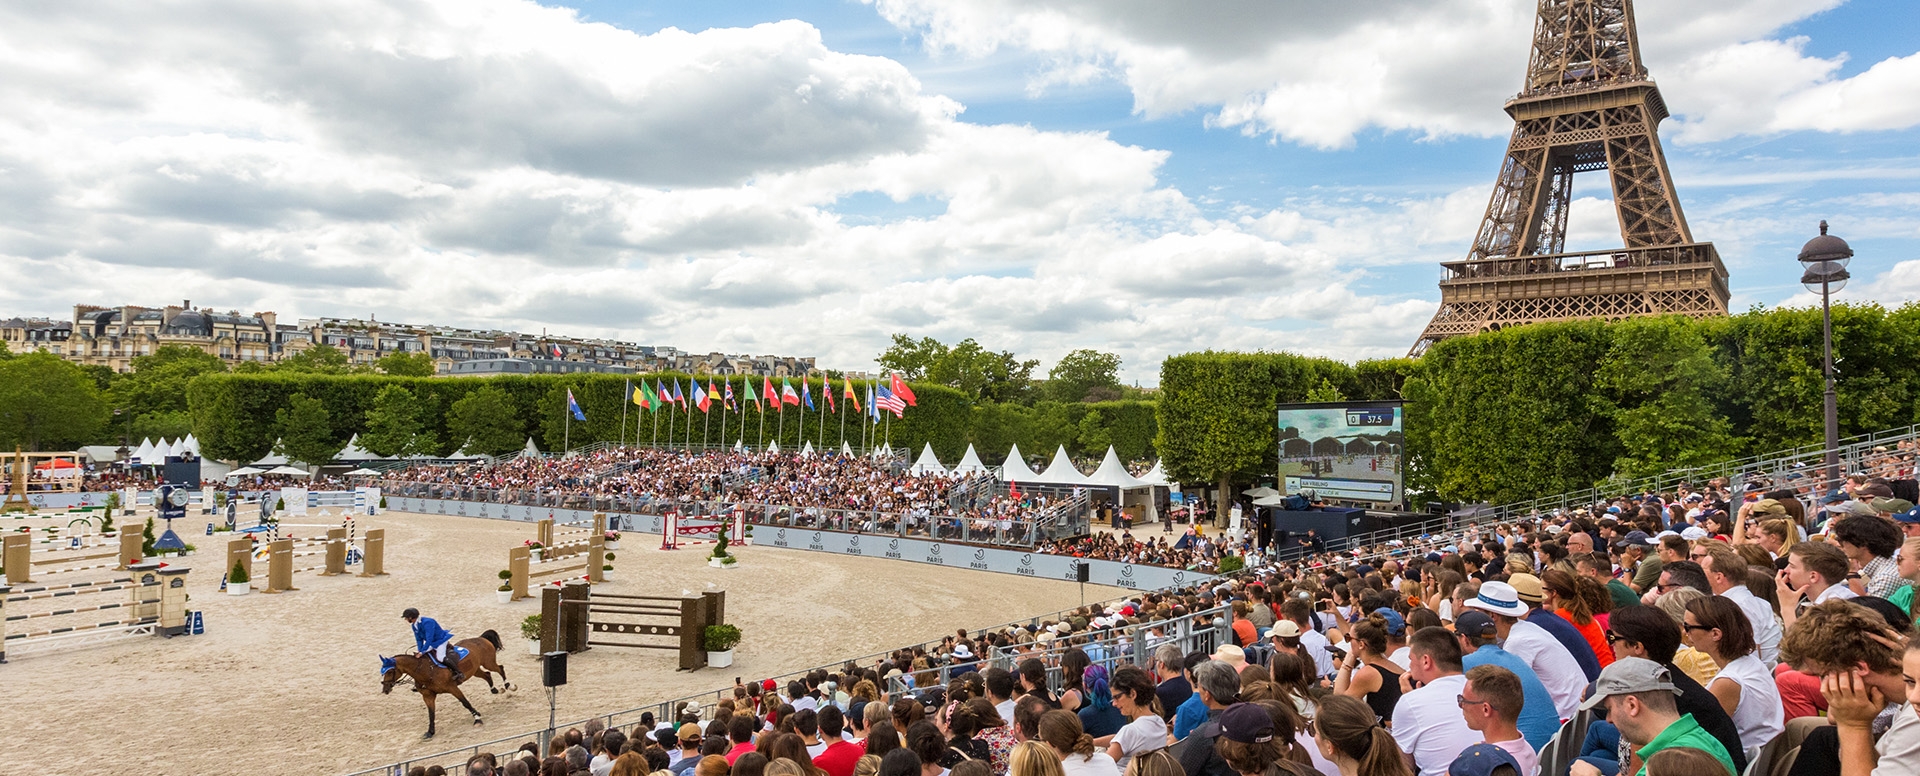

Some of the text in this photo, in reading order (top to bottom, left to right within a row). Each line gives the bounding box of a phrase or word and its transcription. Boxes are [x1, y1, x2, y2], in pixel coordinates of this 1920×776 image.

[1351, 415, 1356, 423] 0
[1367, 415, 1382, 424] 37.5
[846, 547, 862, 555] PARIS
[885, 551, 901, 559] PARIS
[926, 556, 943, 564] PARIS
[970, 562, 988, 570] PARIS
[1016, 567, 1035, 575] PARIS
[1065, 572, 1078, 580] PAR
[1116, 579, 1137, 588] PARIS
